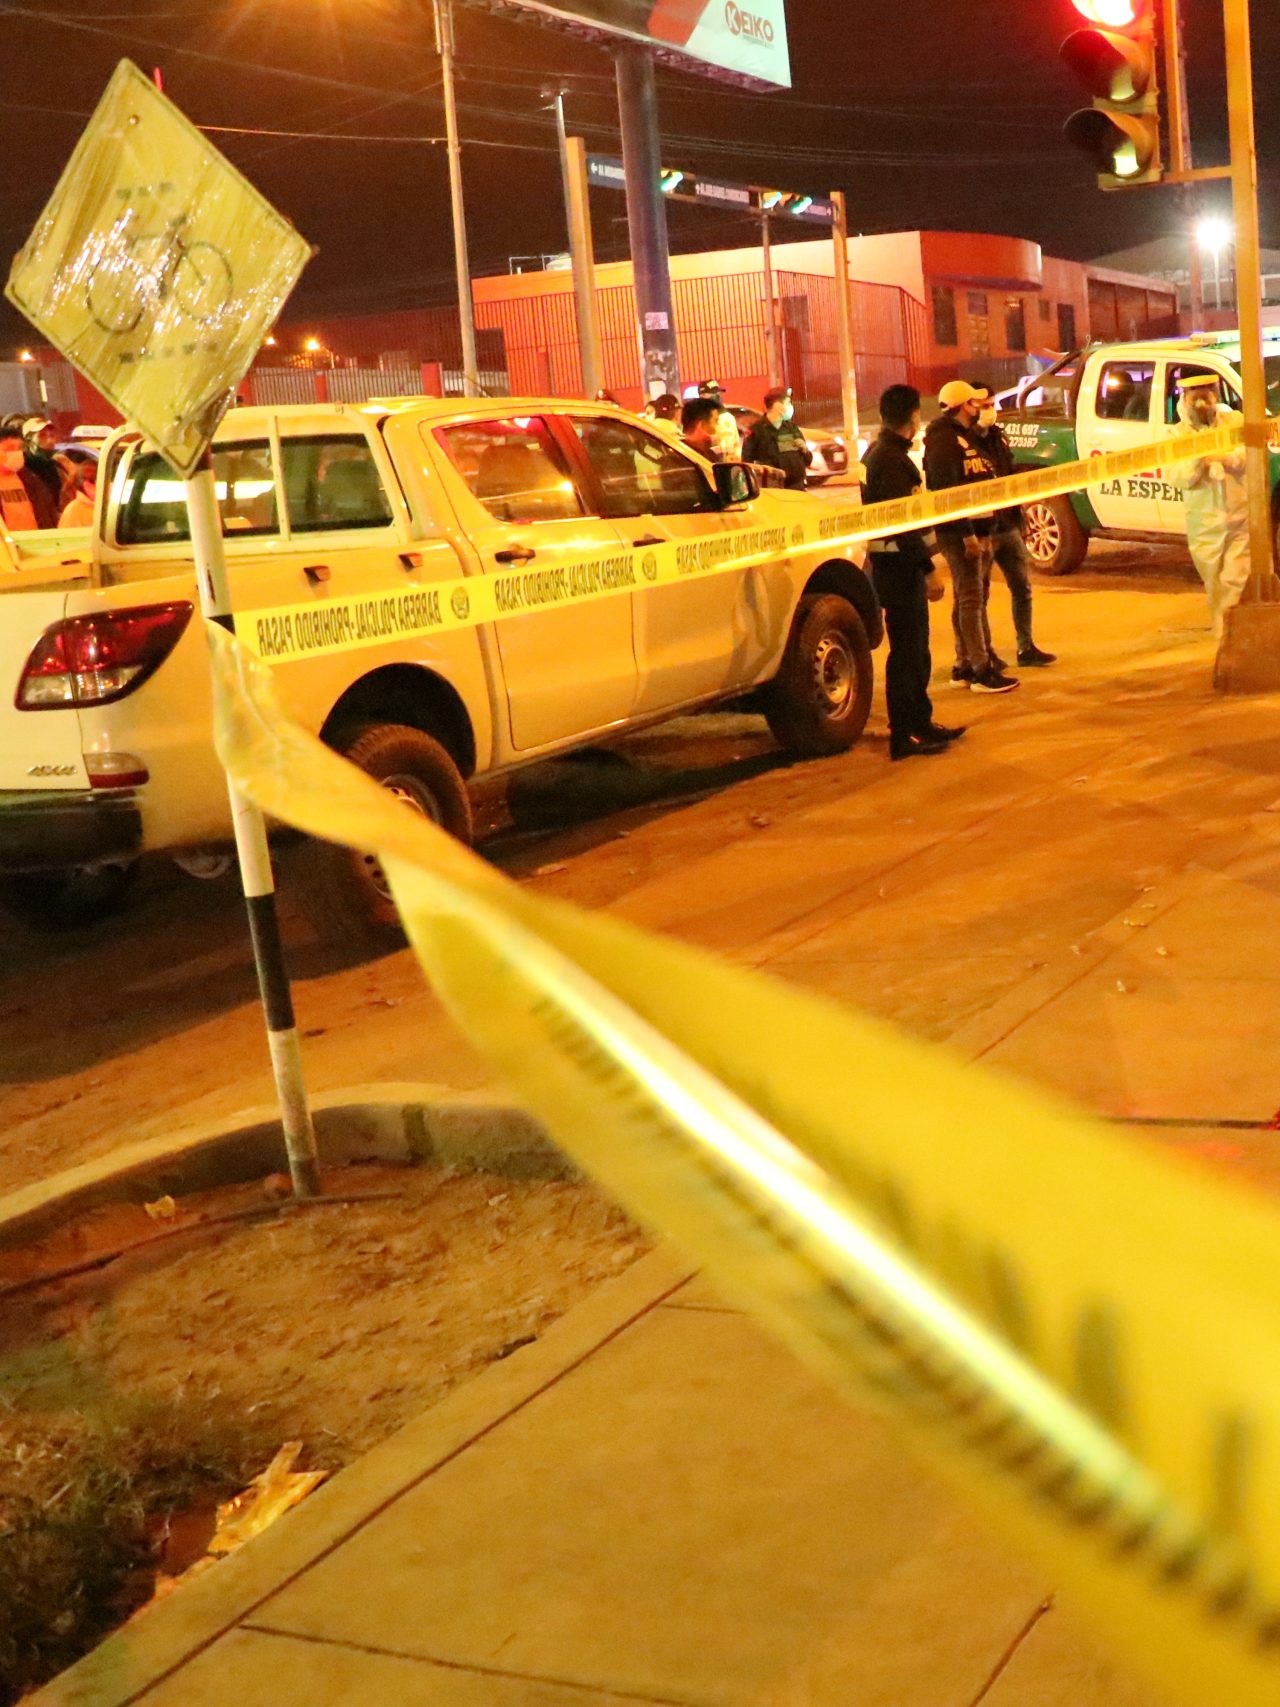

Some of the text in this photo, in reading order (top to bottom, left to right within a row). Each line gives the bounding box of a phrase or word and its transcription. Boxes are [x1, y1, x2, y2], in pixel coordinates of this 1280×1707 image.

[725, 1, 774, 42] KEIKO
[1100, 480, 1185, 503] LA ESPER
